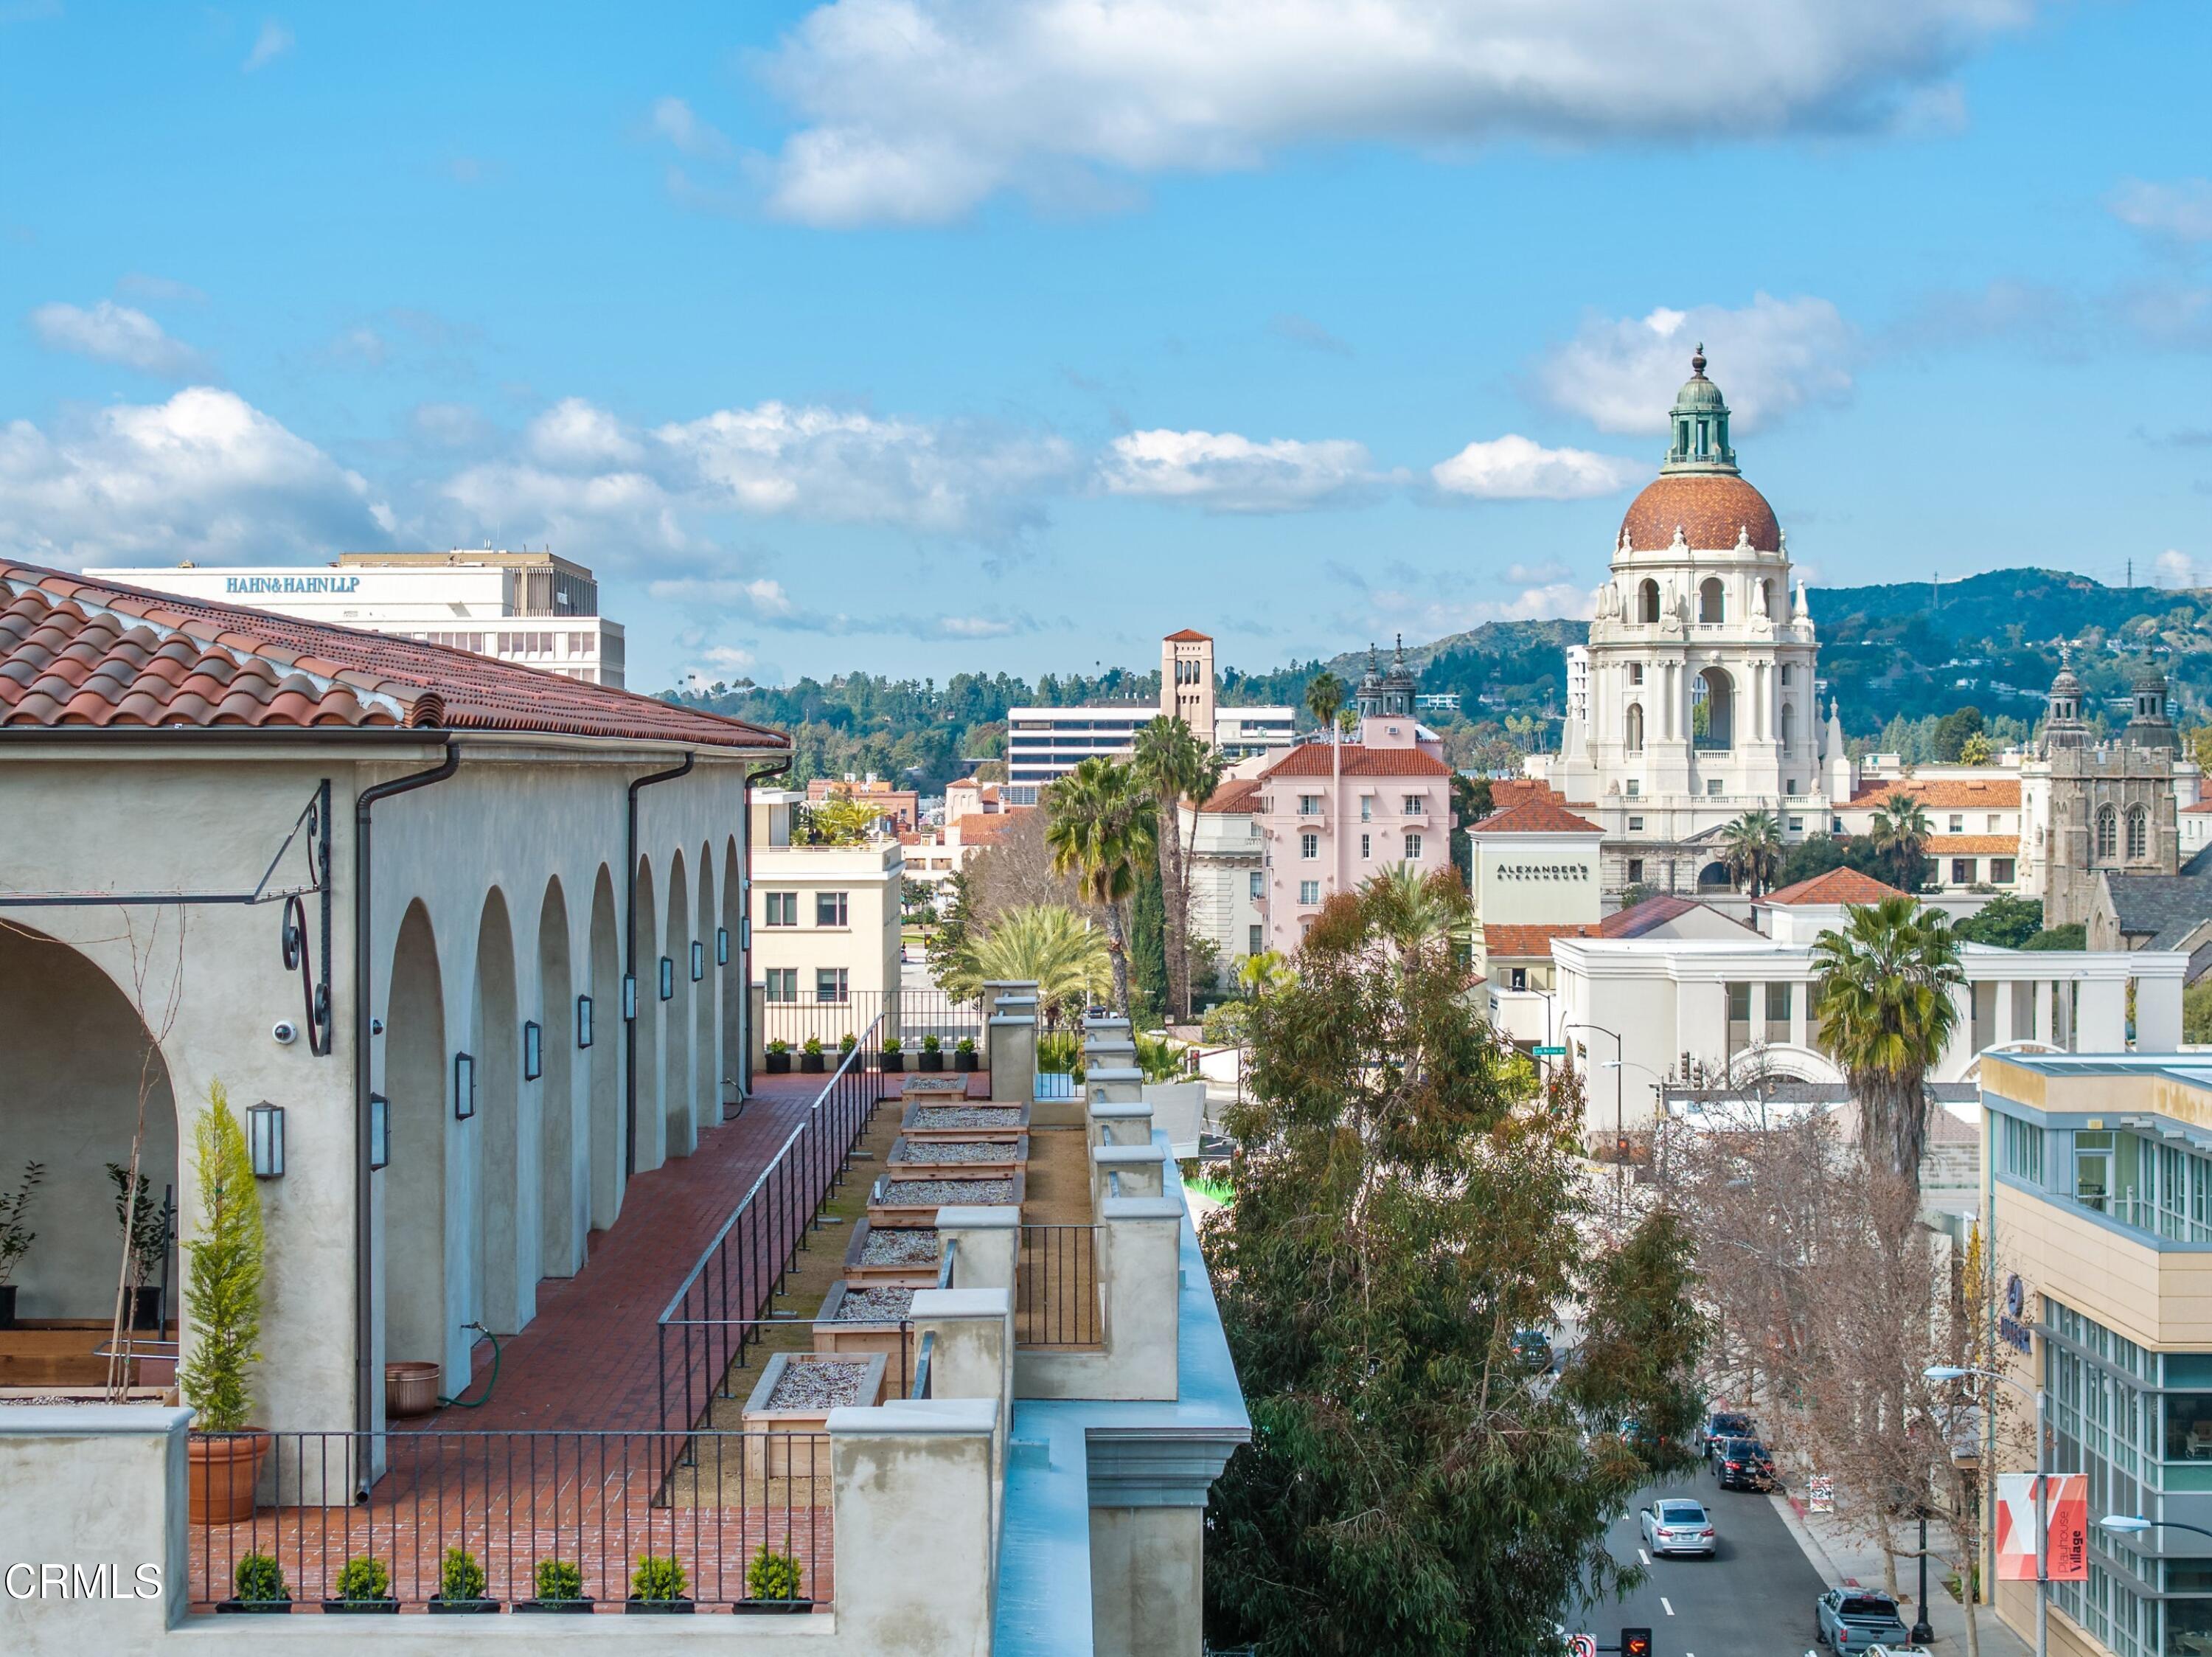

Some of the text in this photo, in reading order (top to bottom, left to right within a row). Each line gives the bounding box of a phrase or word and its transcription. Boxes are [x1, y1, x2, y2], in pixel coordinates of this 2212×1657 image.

[330, 577, 361, 593] LLP
[1497, 863, 1588, 873] ALEXANDER'S
[2058, 1511, 2070, 1573] Playhouse
[2070, 1530, 2083, 1572] Village
